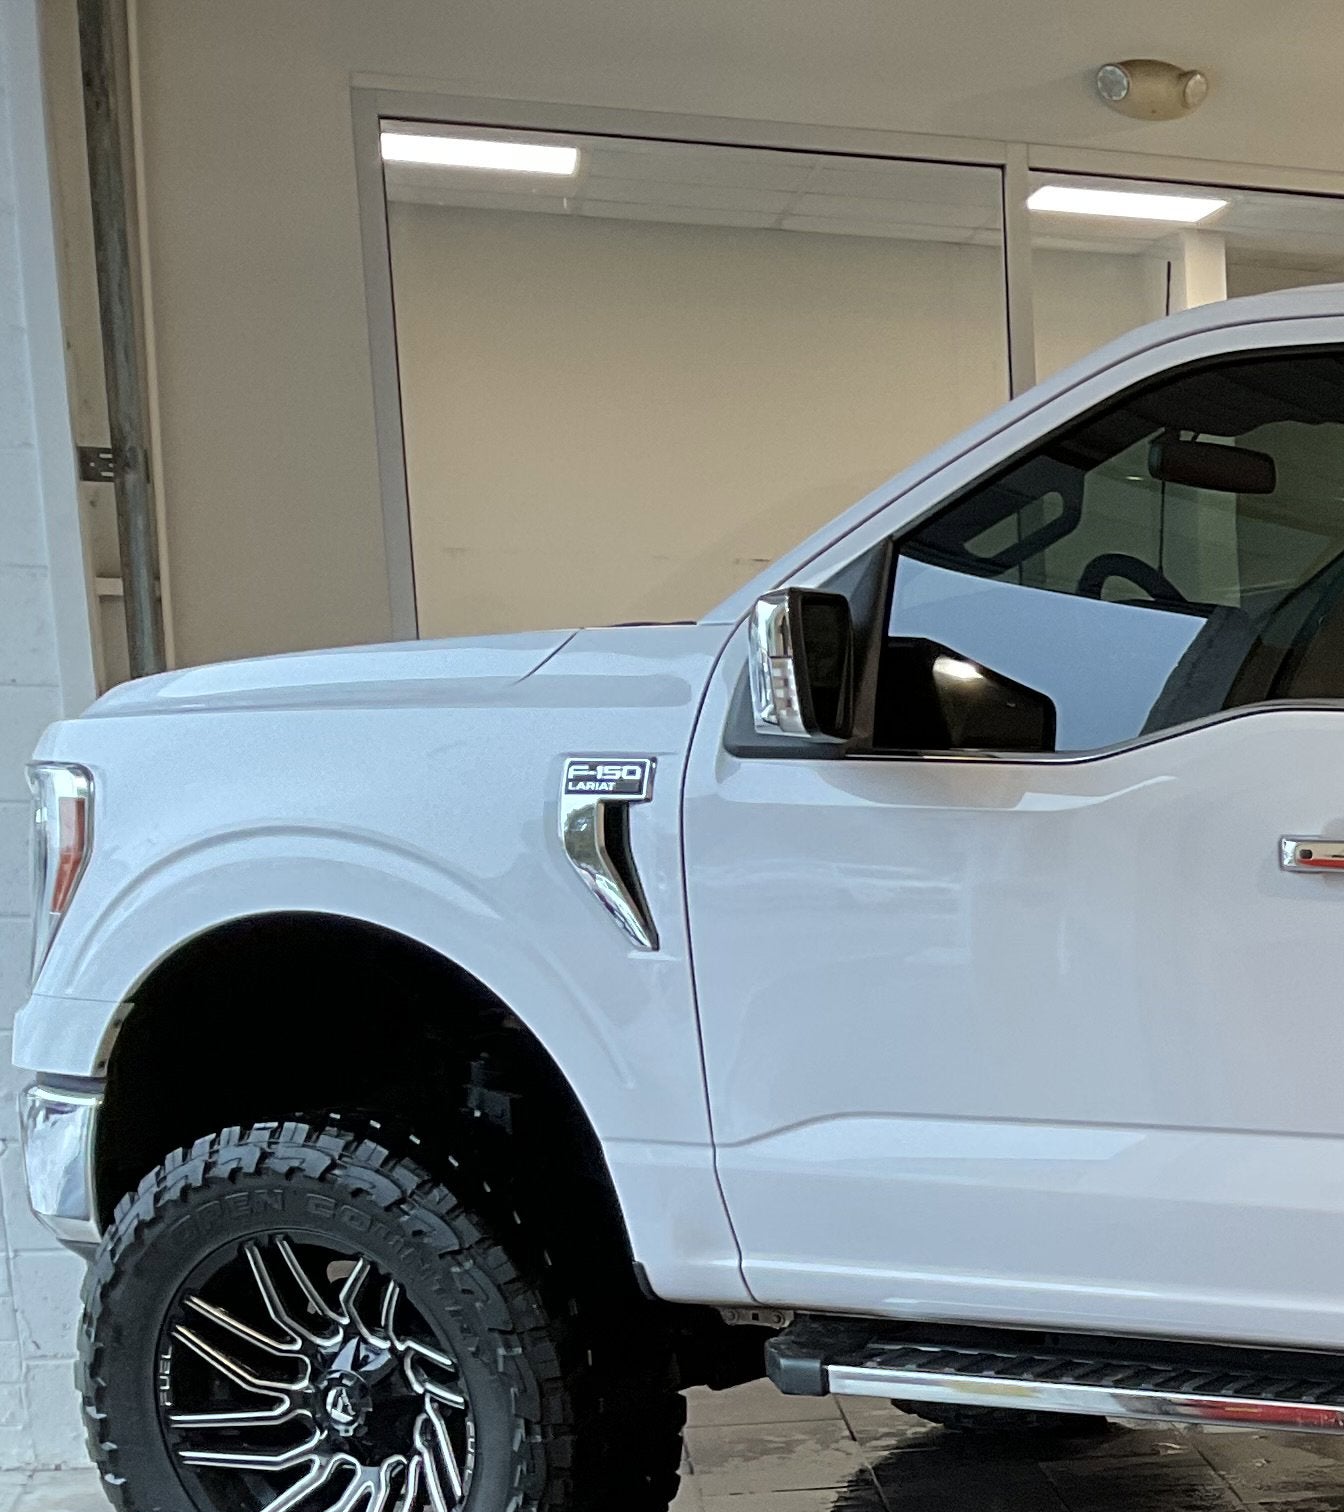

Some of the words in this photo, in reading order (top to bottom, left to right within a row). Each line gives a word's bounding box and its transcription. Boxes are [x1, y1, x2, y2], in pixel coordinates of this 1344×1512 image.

[567, 765, 642, 780] F-150
[568, 781, 617, 791] LARIAT
[159, 1345, 172, 1406] FUEL
